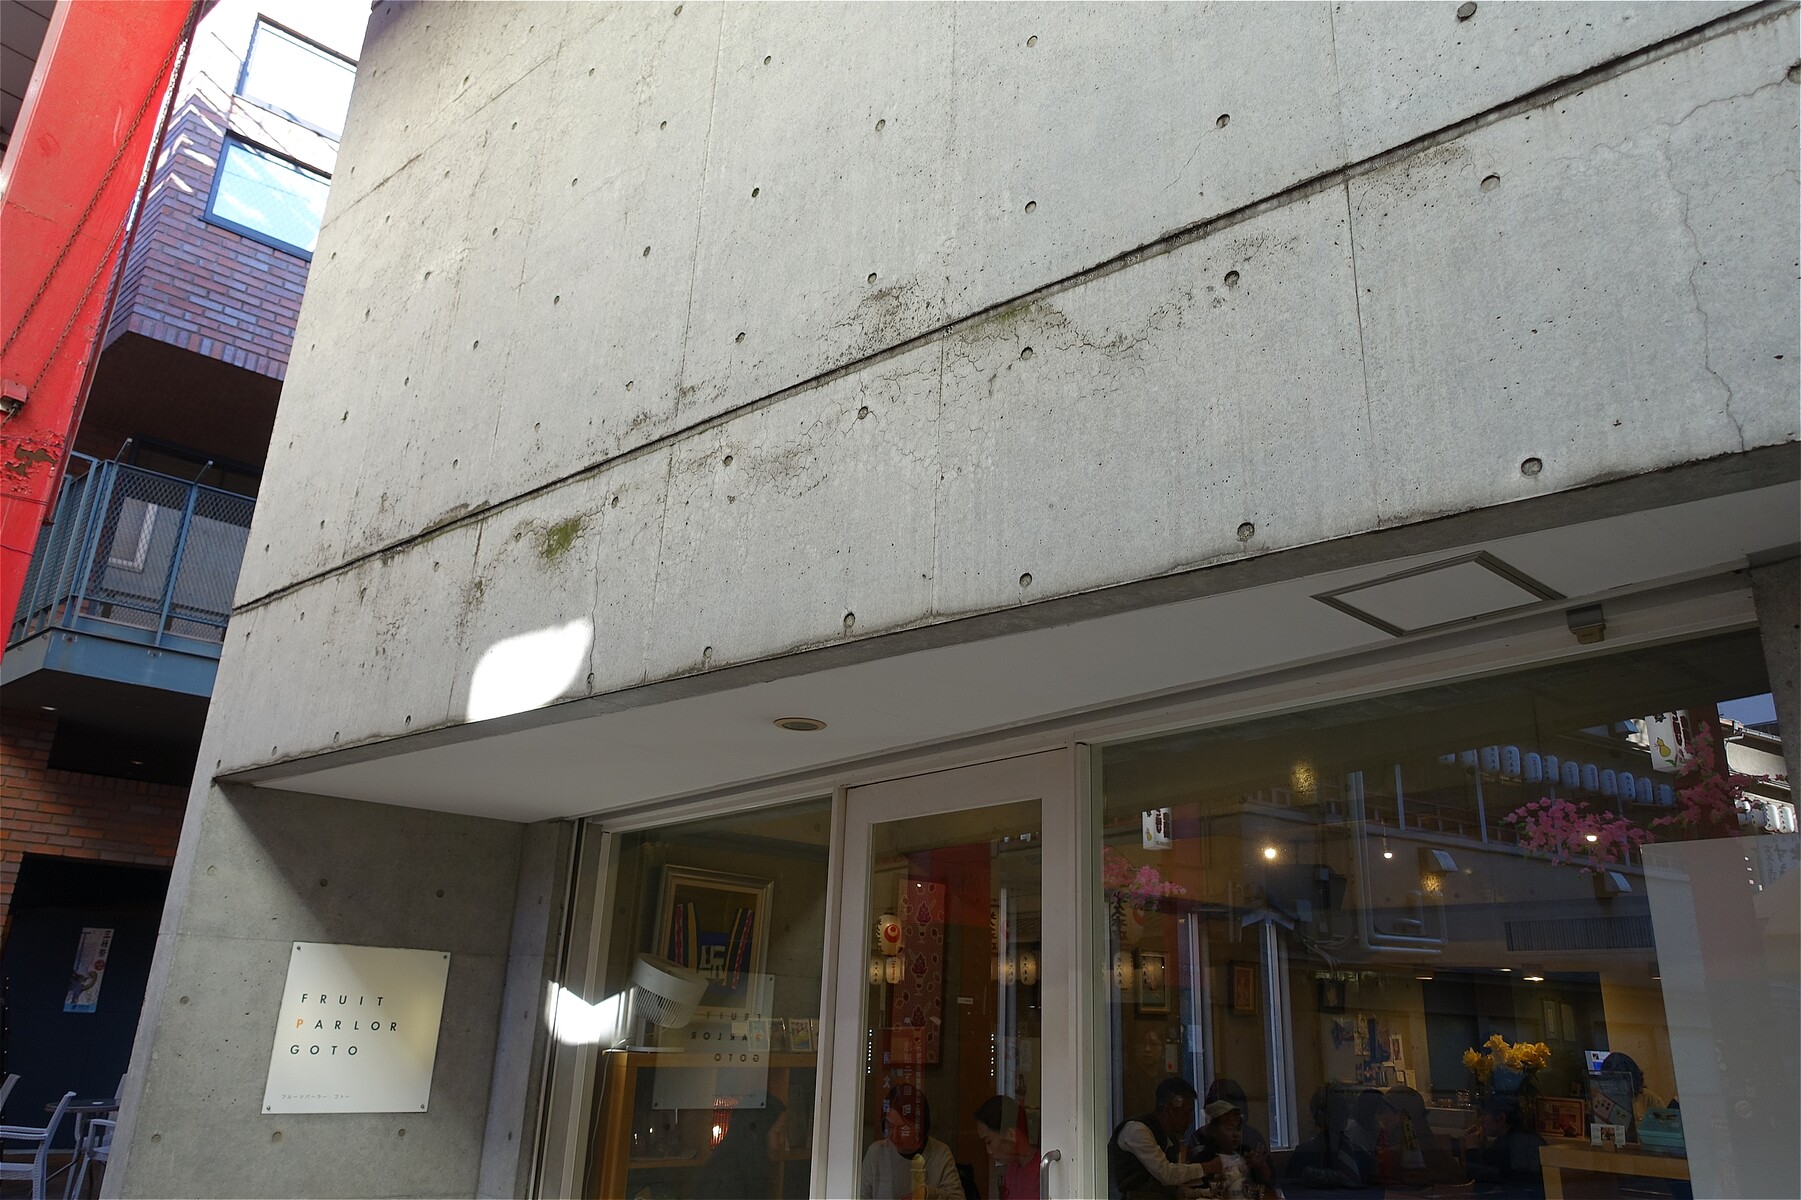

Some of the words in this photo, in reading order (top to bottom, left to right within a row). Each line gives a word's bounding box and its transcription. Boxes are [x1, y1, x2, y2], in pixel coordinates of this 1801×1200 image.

[301, 993, 383, 1006] FRUIT
[295, 1018, 397, 1032] PARLOR
[290, 1044, 358, 1056] GOTO
